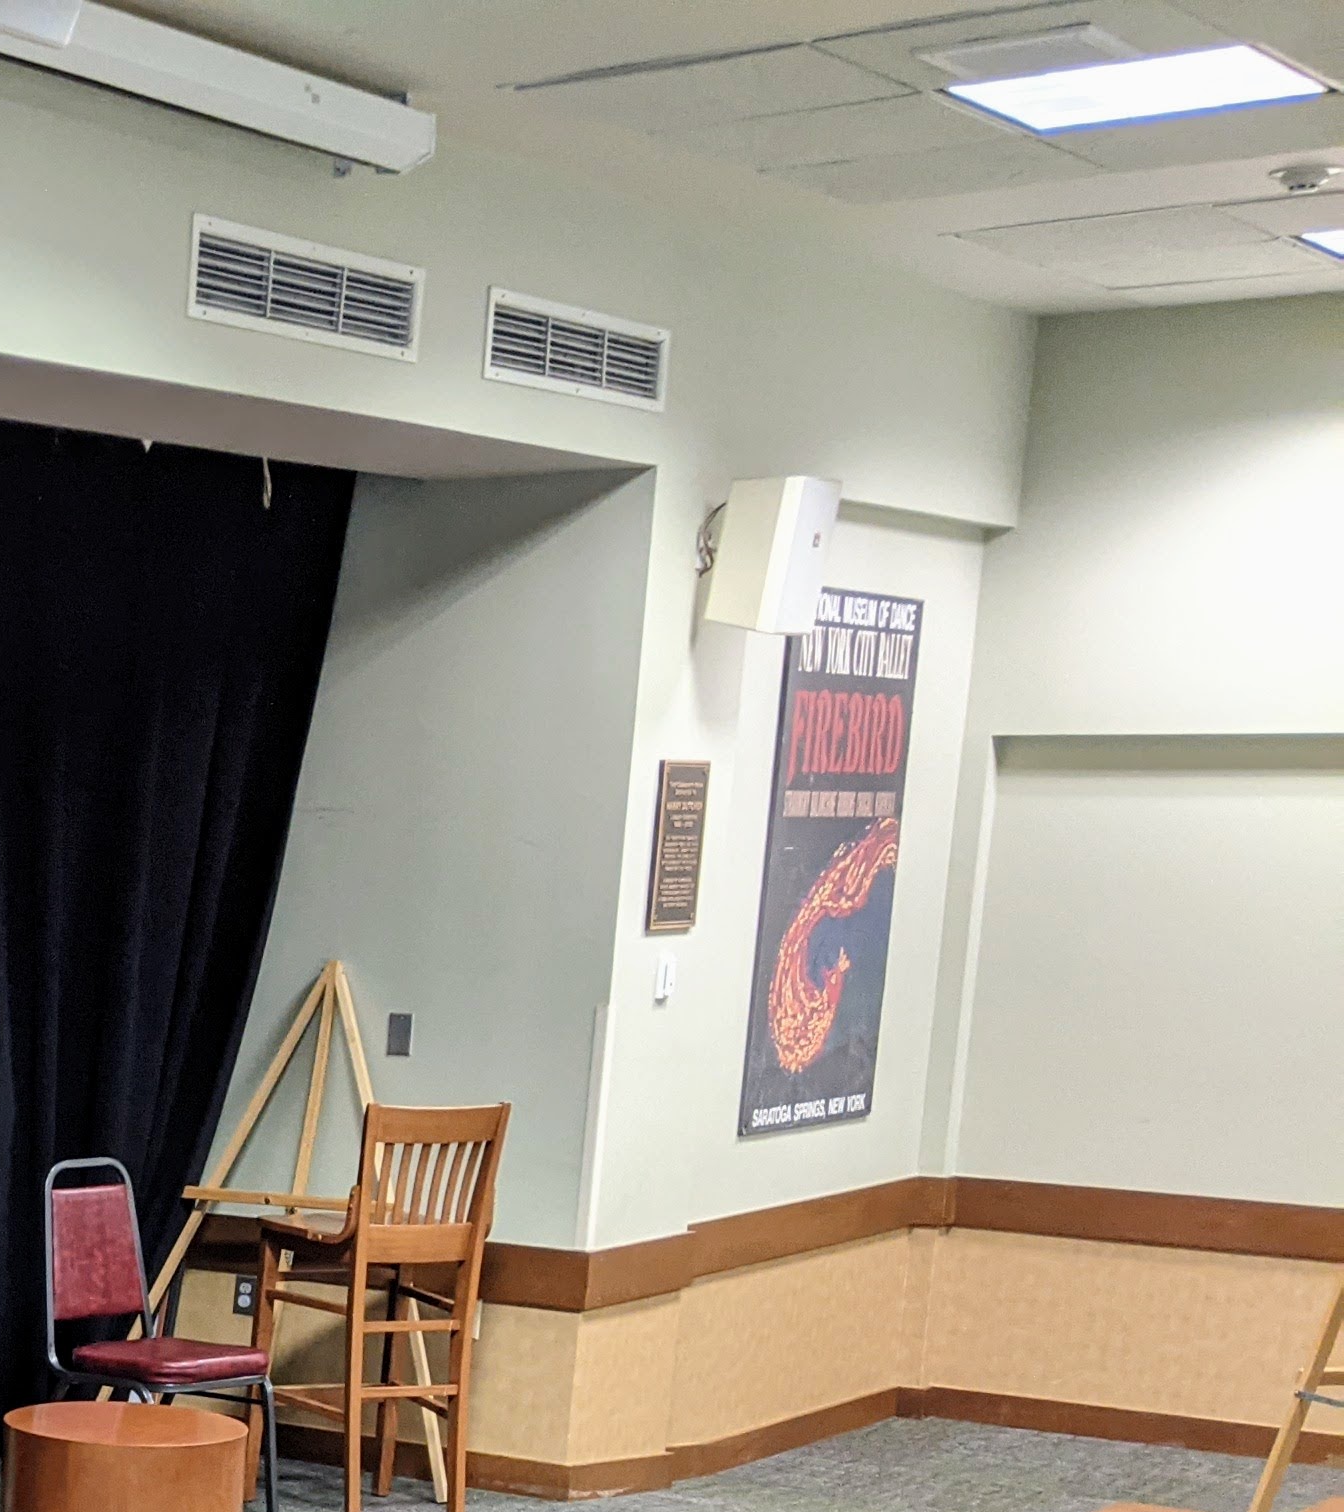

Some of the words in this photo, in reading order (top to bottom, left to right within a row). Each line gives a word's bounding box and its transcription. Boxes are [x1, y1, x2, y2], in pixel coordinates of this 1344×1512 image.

[843, 596, 878, 627] MUSEUM
[878, 600, 891, 629] OF
[890, 602, 917, 632] DANCE
[798, 626, 827, 673] NEW
[826, 627, 854, 675] YORK
[853, 630, 878, 677] CITY
[876, 632, 914, 680] BALLET
[786, 688, 905, 786] FIREBIRD
[752, 1104, 792, 1128] SARATOGA
[793, 1099, 826, 1122] SPRINGS,
[828, 1096, 846, 1116] NEW
[847, 1093, 867, 1113] YORK
